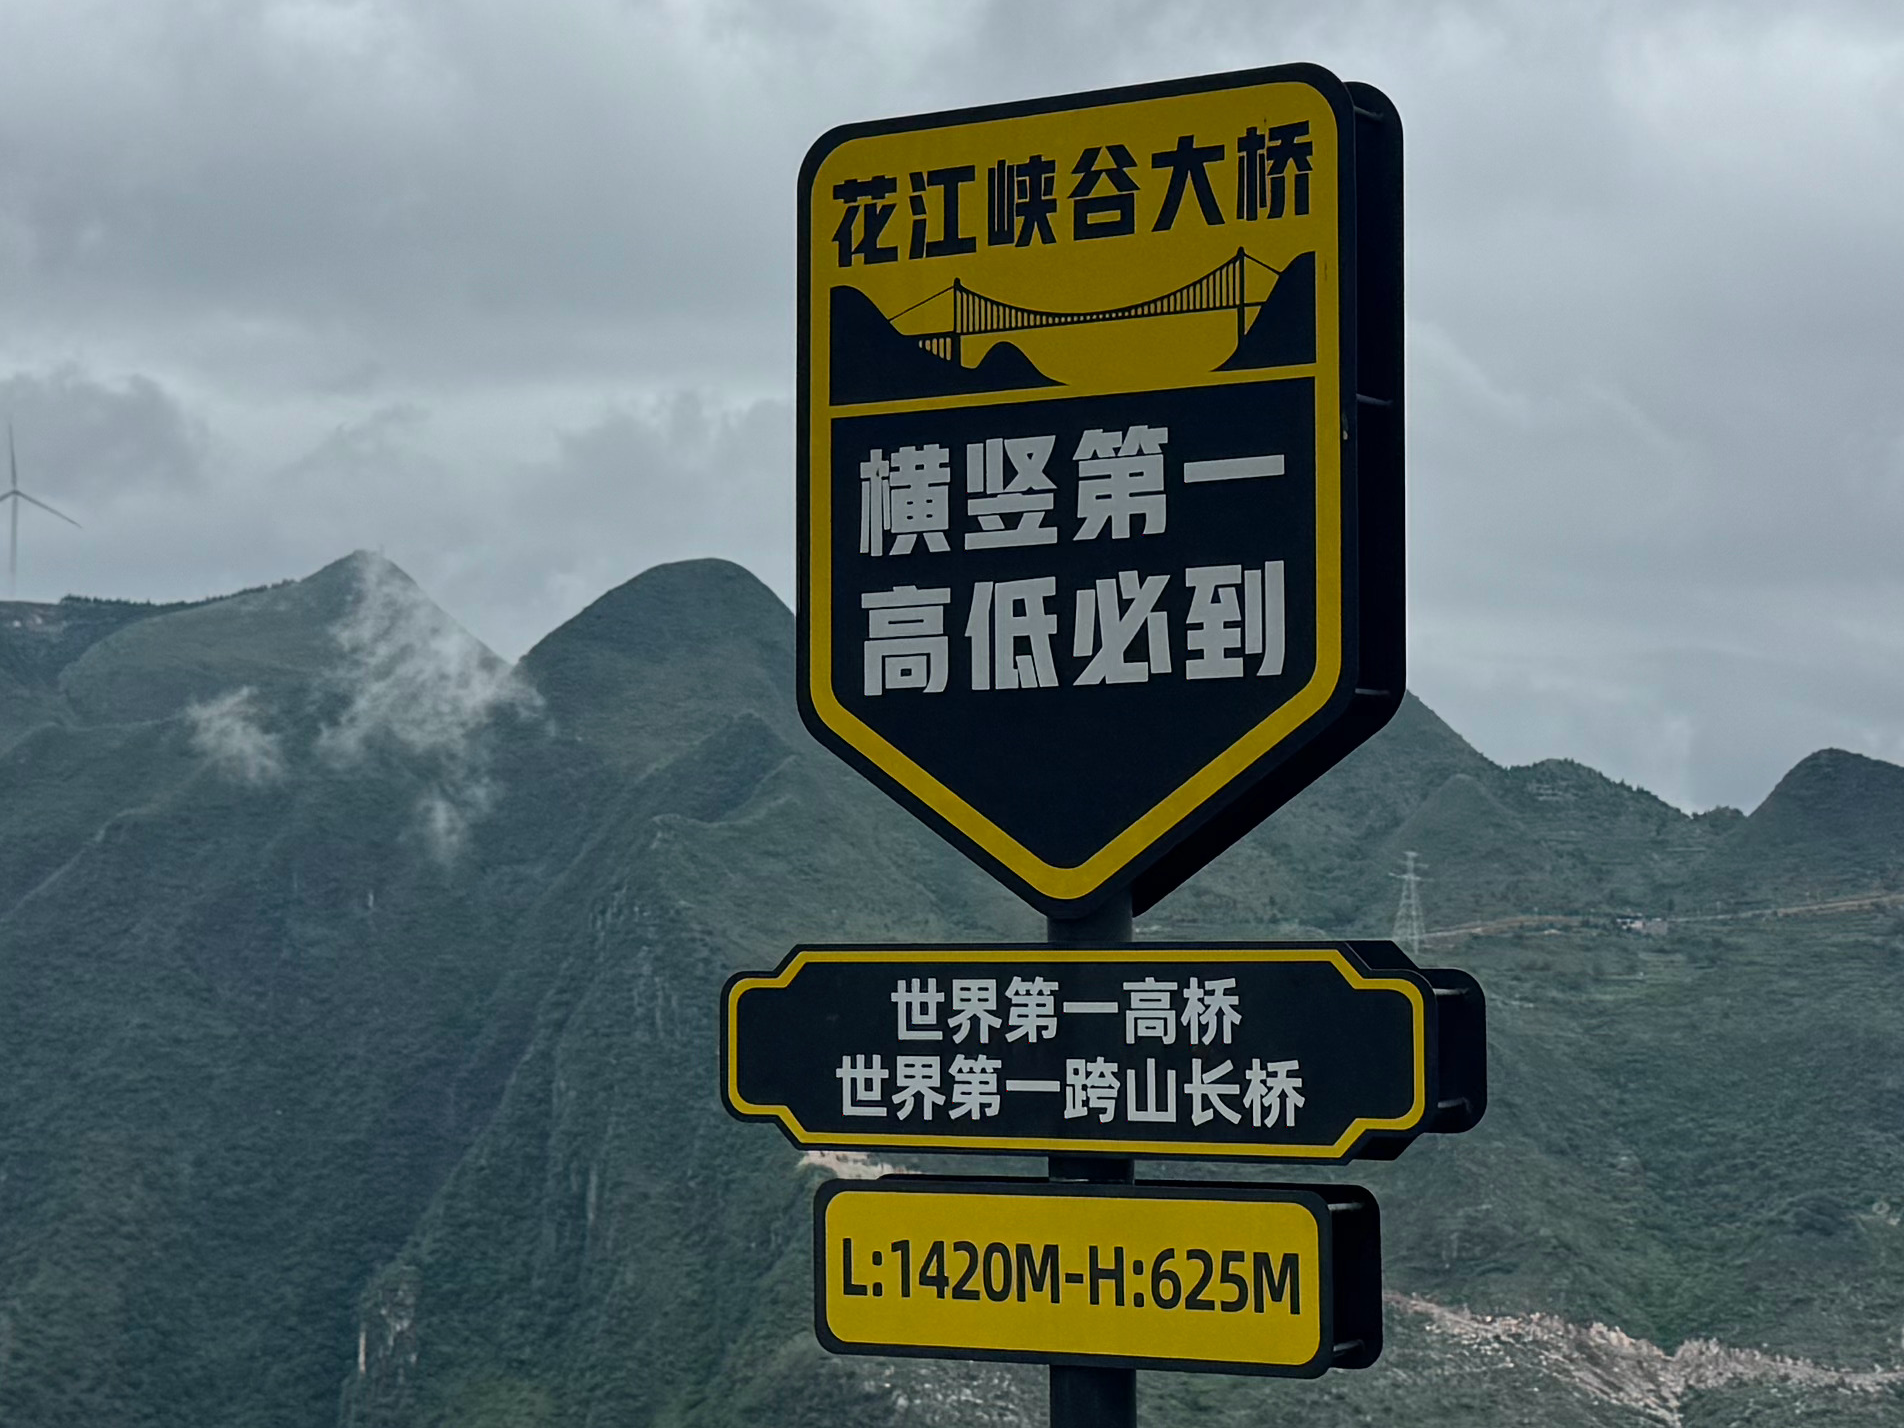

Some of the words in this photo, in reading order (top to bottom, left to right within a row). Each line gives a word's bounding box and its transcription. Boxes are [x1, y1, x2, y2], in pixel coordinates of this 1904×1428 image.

[832, 119, 1313, 267] 花江峡谷大桥
[860, 425, 1285, 556] 横竖第一
[860, 561, 1285, 697] 高低必到
[891, 976, 1242, 1045] 世界第一高桥
[836, 1054, 1305, 1128] 世界第一跨山长桥
[842, 1237, 1301, 1315] L:1420M-H:625M
